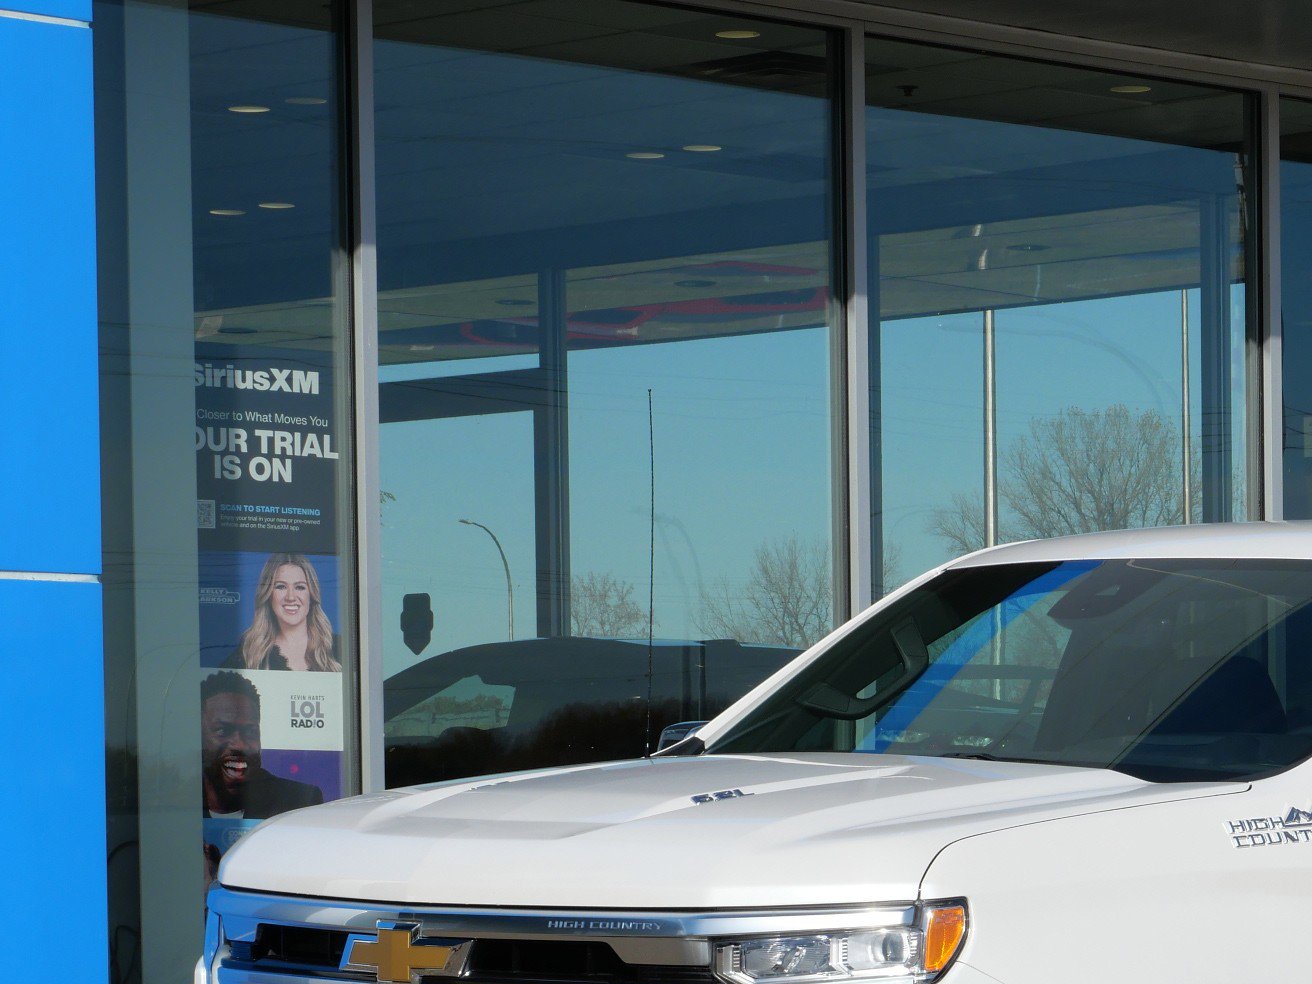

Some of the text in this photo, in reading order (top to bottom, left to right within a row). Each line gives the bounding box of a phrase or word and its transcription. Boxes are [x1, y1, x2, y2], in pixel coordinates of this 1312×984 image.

[196, 408, 329, 427] Closer to What Moves You
[255, 429, 339, 460] TRIAL
[214, 455, 293, 483] IS ON
[220, 503, 321, 516] SCAN TO START LISTENING
[290, 700, 325, 718] LOL
[1223, 816, 1286, 834] HIGH
[548, 920, 664, 930] HIGH COUNTRY
